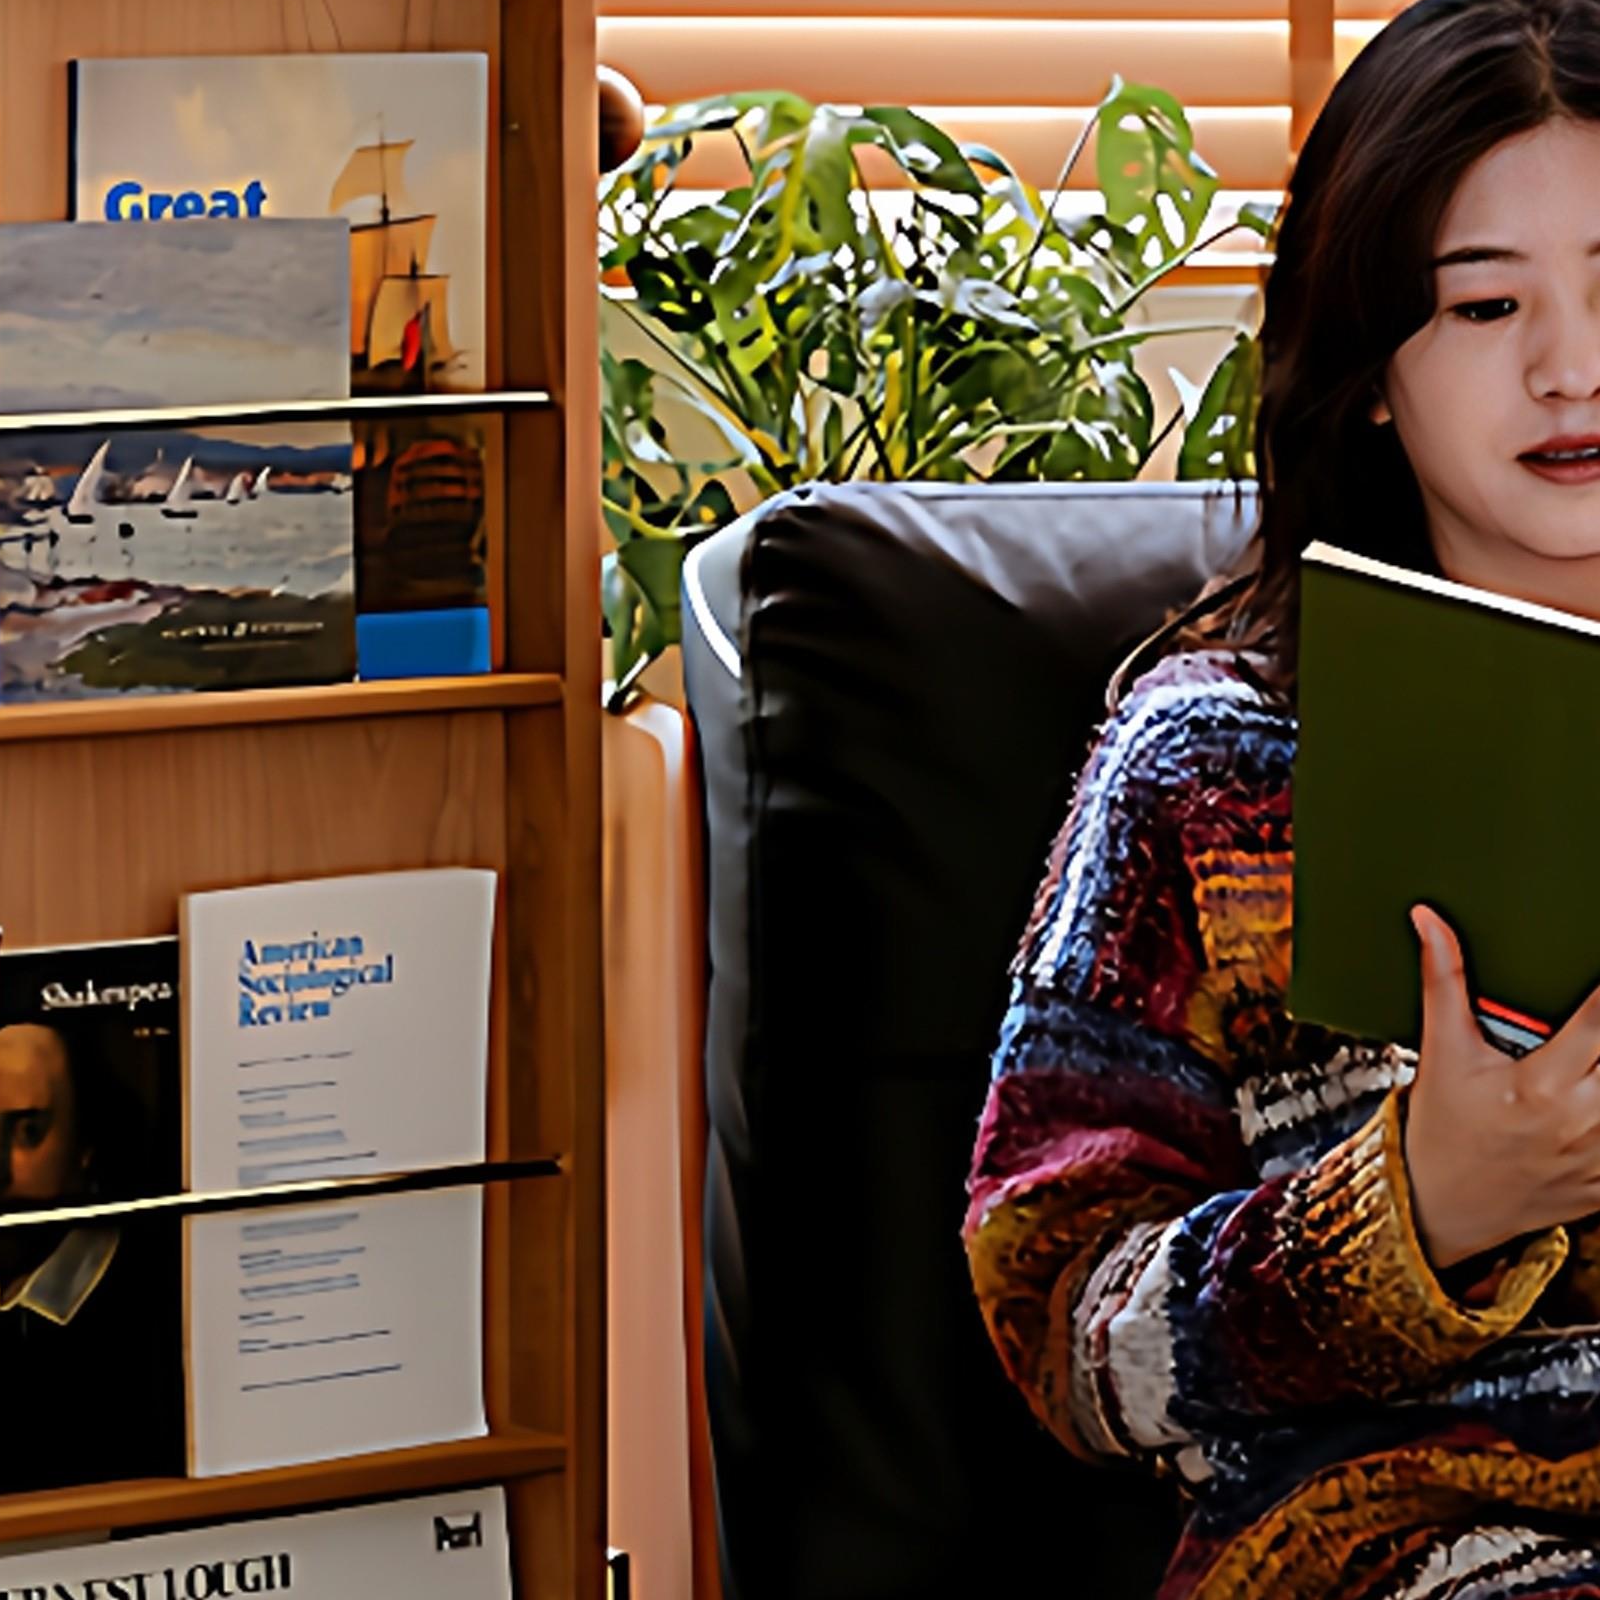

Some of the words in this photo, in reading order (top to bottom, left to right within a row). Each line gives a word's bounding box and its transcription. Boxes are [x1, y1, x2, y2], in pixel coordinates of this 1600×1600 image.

[105, 180, 267, 222] Great
[243, 931, 364, 966] American
[238, 954, 394, 997] Sociological
[238, 991, 330, 1028] Review
